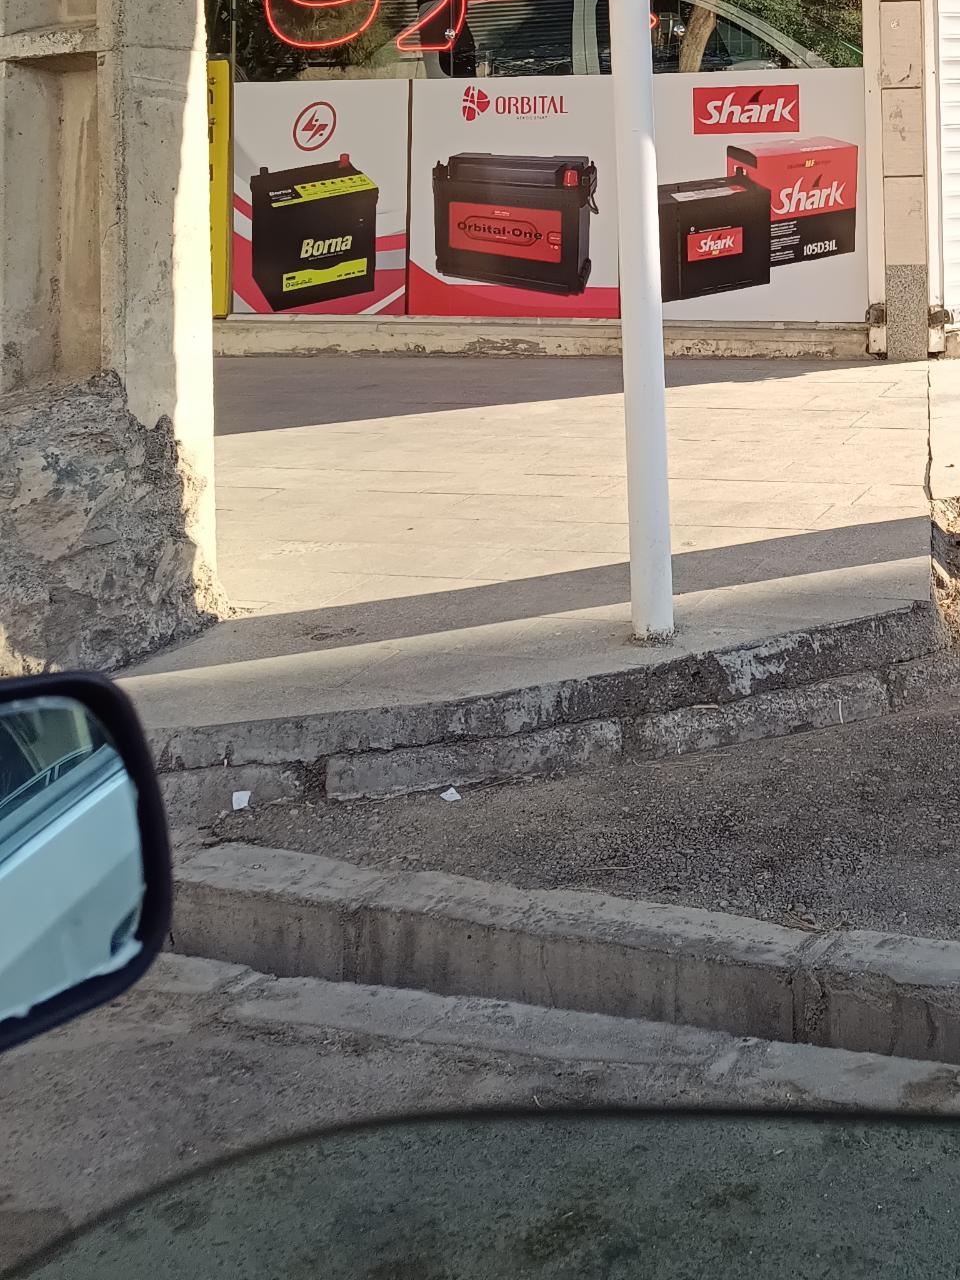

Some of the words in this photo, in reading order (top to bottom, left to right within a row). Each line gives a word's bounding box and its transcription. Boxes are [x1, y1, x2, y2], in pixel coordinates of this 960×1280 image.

[495, 95, 569, 115] ORBITAL
[699, 91, 798, 125] Shark
[771, 176, 847, 216] Shark
[300, 234, 353, 259] Borna
[696, 234, 735, 253] Shark
[803, 238, 838, 257] 105D31L
